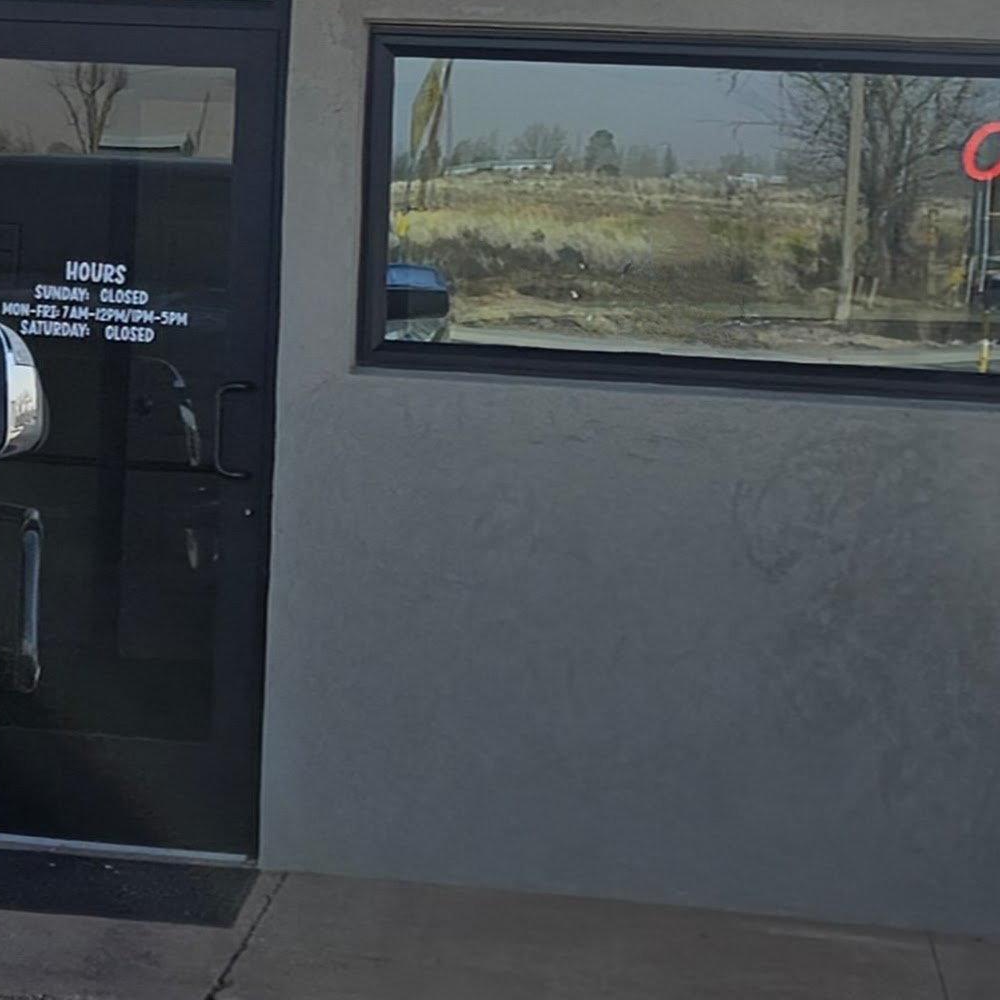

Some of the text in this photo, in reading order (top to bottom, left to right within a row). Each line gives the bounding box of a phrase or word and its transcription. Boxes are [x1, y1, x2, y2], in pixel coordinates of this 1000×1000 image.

[65, 260, 127, 285] HOURS
[34, 284, 149, 305] SUNDAY: CLOSED
[19, 319, 155, 343] SATURDAY: CLOSED
